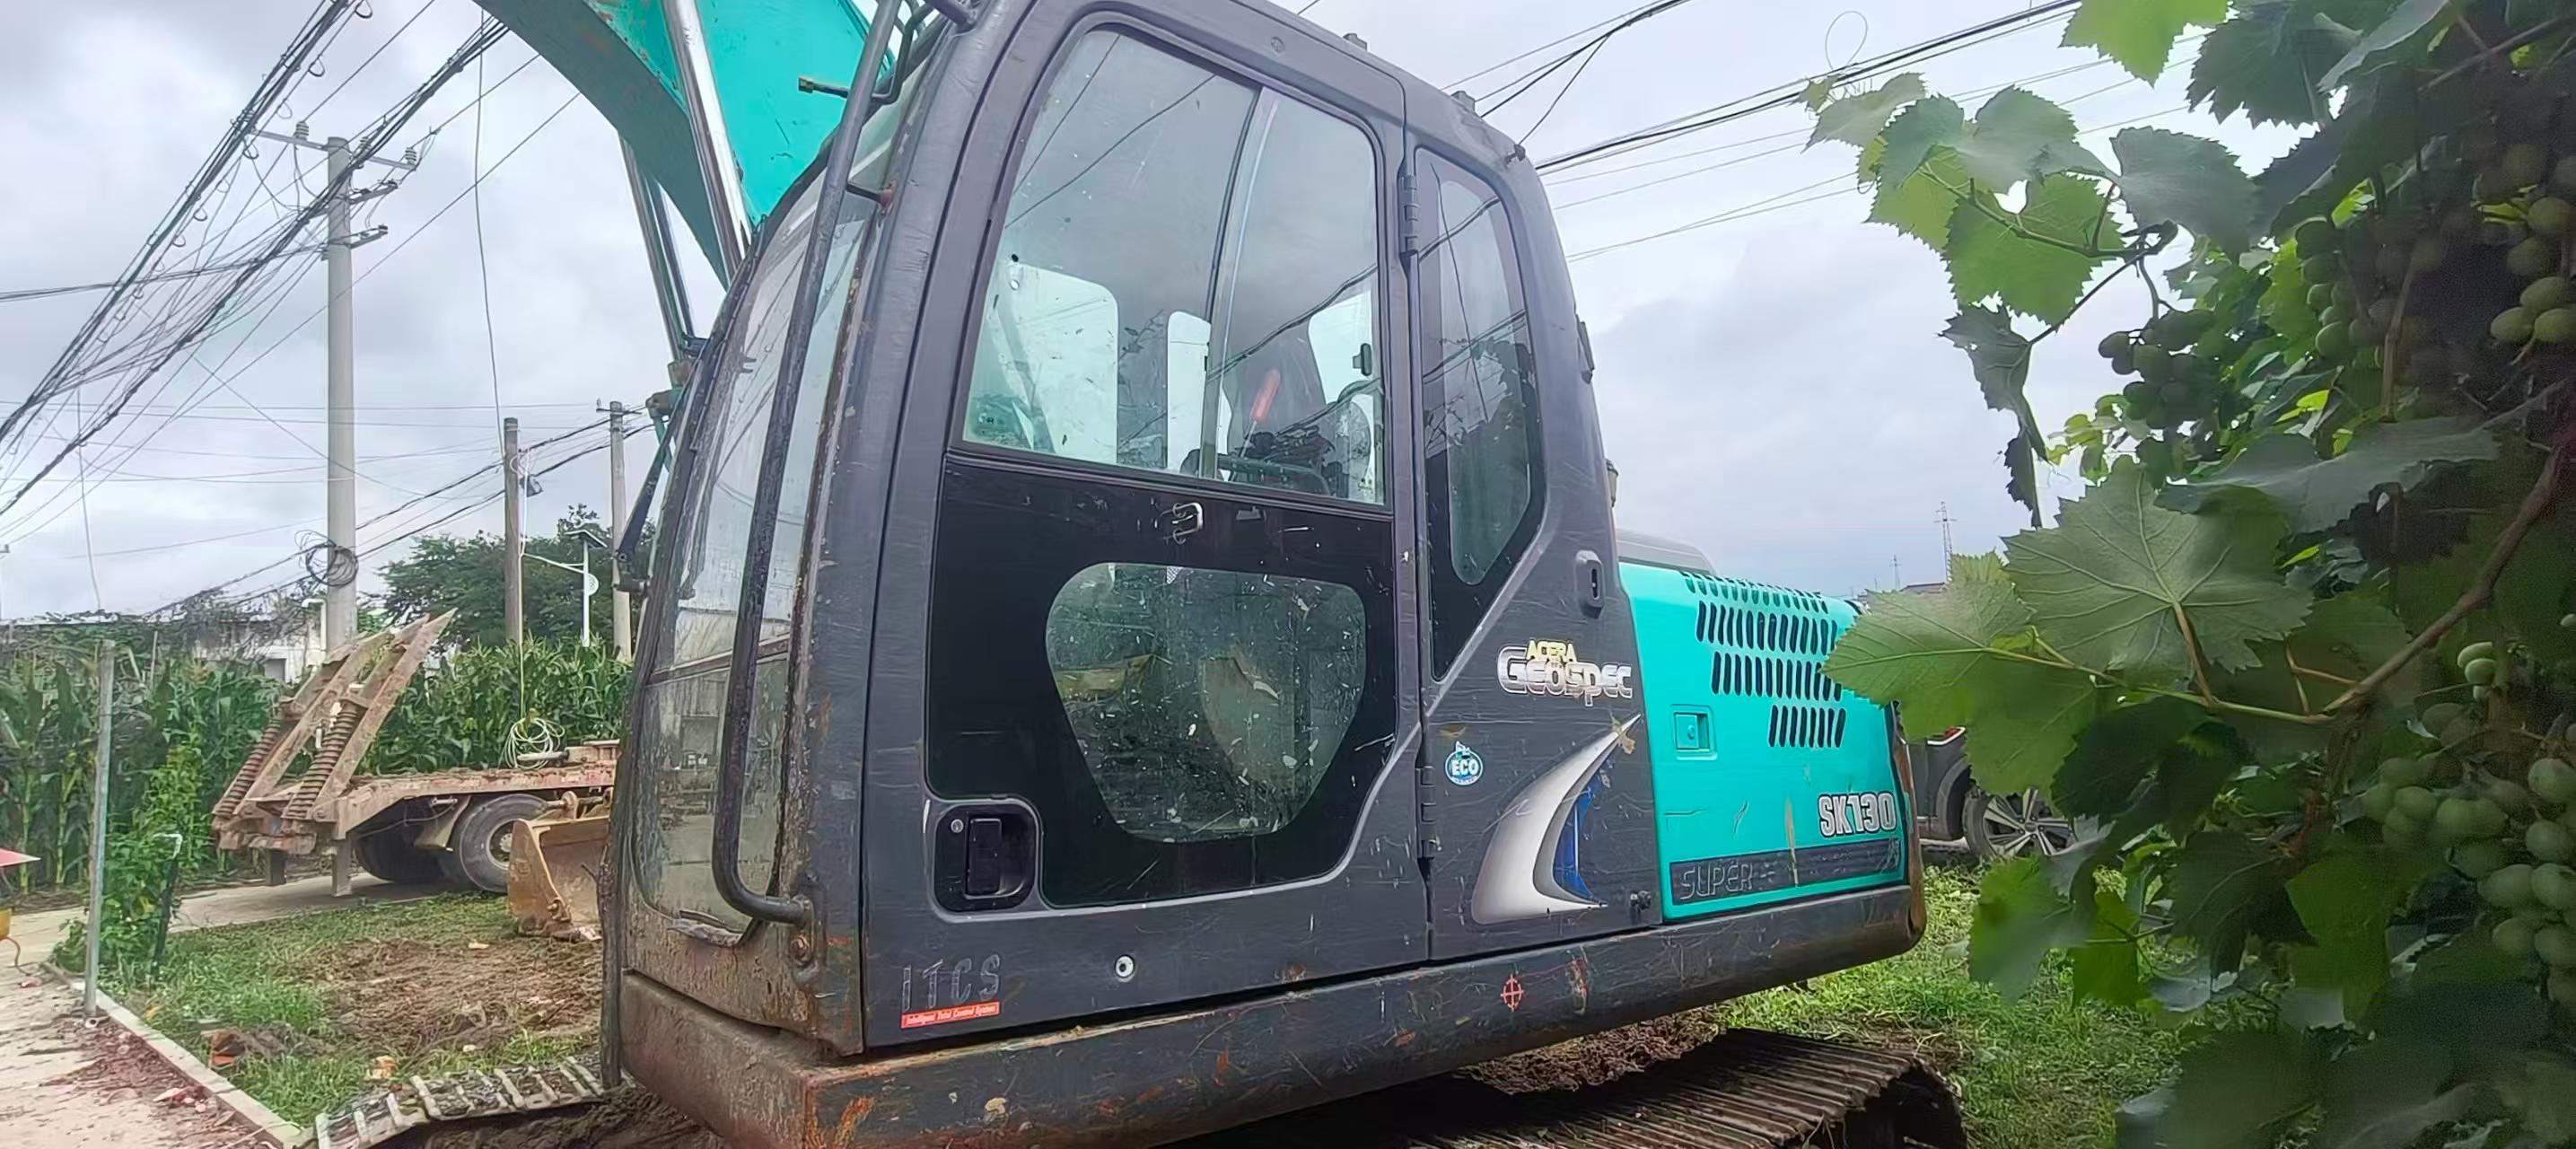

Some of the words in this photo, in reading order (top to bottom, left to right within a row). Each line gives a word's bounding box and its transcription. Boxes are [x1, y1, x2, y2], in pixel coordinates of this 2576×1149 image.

[1526, 639, 1578, 662] ACERA
[1450, 759, 1479, 776] ECO
[1818, 794, 1897, 838] SK130
[1679, 859, 1753, 900] SUPER
[902, 954, 1000, 1012] ITCS
